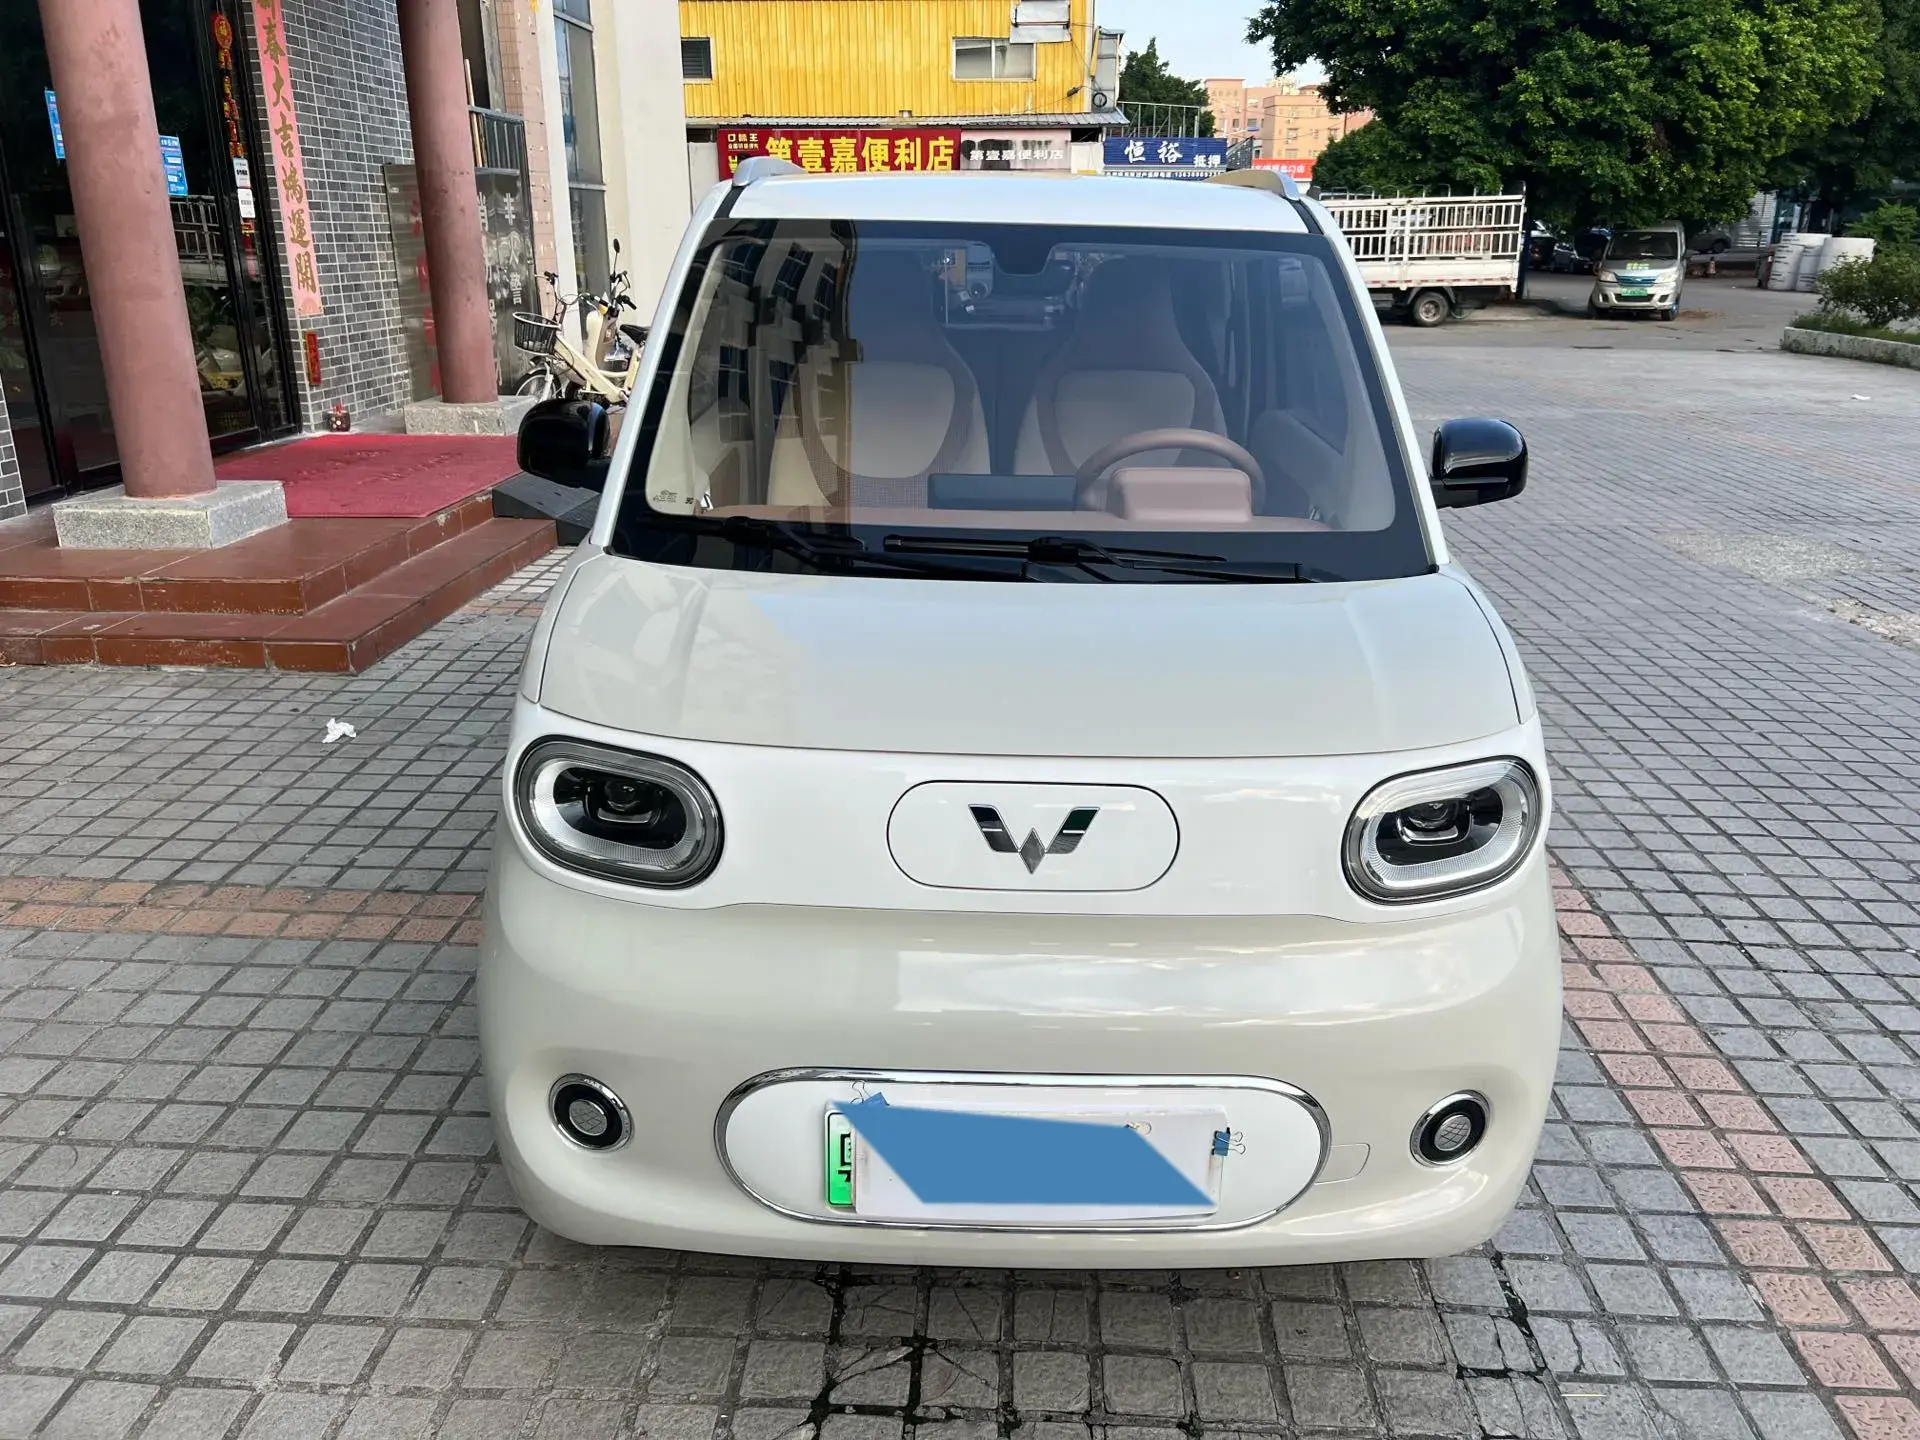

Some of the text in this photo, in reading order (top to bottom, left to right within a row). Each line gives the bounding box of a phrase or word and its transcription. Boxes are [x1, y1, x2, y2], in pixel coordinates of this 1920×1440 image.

[765, 136, 954, 172] 第壹嘉便利店
[969, 150, 1064, 160] 第壹嘉便利店
[1124, 140, 1183, 163] 恒裕
[1193, 155, 1220, 168] 抵押
